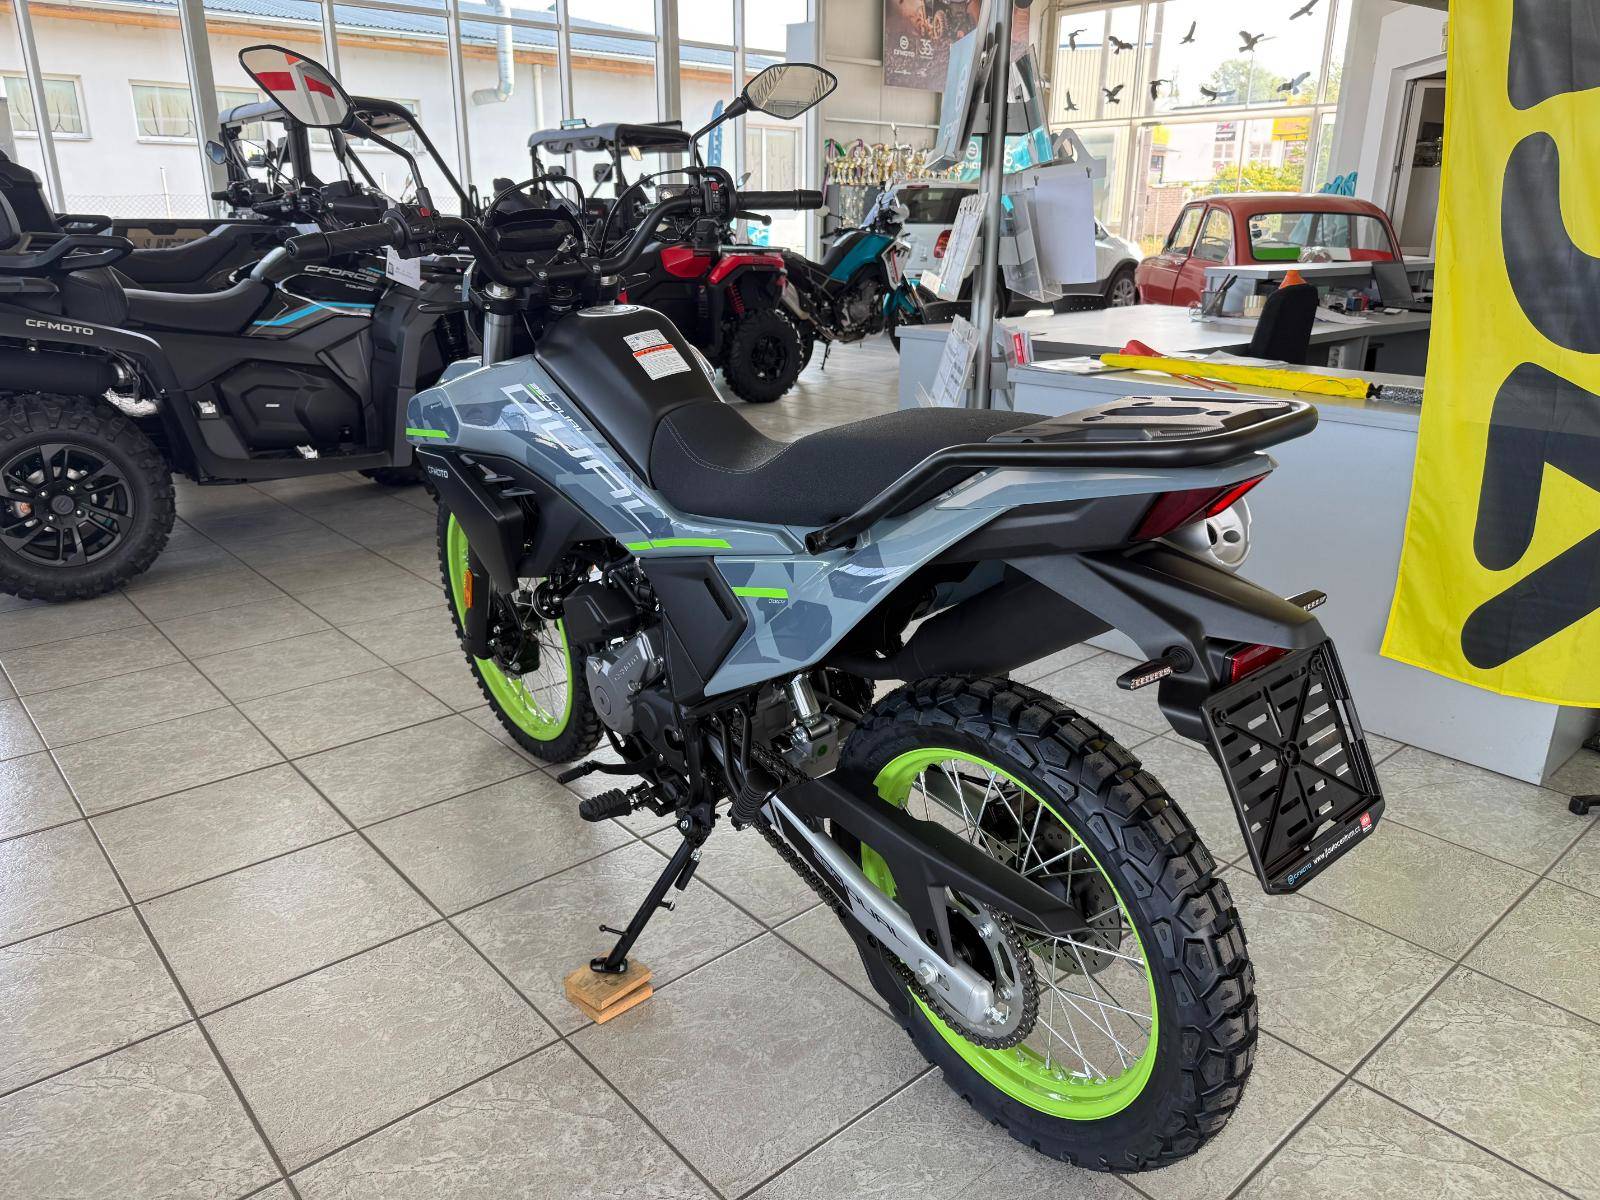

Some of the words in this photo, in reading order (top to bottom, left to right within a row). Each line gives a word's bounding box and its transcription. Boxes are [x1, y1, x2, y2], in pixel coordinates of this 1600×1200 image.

[303, 264, 379, 284] CFORCE
[25, 318, 94, 336] CFMOTO
[500, 383, 652, 535] DUAL
[1294, 863, 1312, 879] CFMOTO
